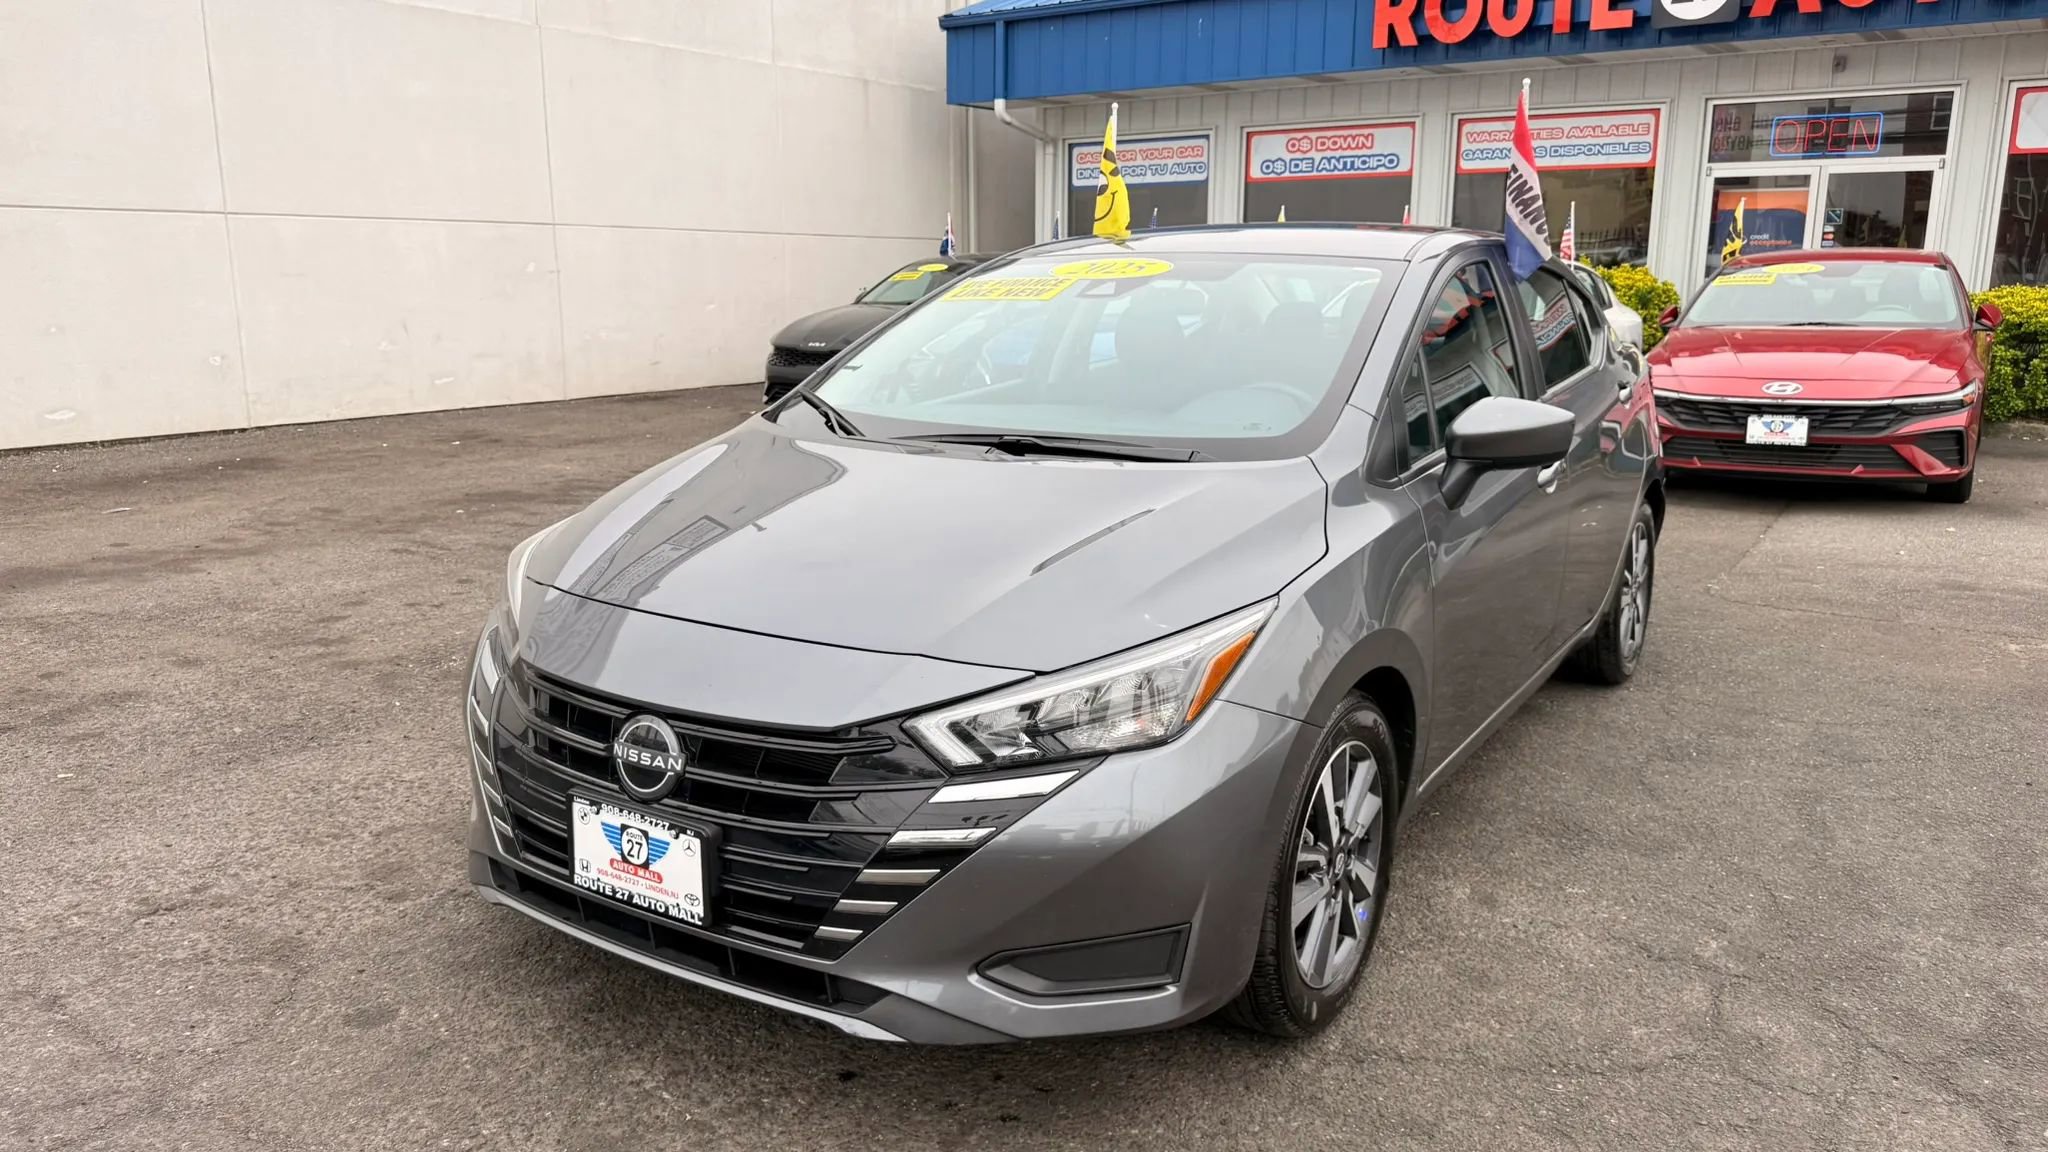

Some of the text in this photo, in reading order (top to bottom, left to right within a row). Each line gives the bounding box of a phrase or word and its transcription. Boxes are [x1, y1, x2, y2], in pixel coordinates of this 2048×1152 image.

[1315, 133, 1374, 152] DOWN
[1467, 123, 1651, 144] WARRATIES AVAILABLE
[1775, 118, 1880, 152] OPEN
[1077, 151, 1103, 165] CAS
[1140, 147, 1174, 161] YOUR
[1176, 146, 1203, 159] CAR
[1462, 141, 1652, 162] GARANS DISPONIBLES
[1077, 162, 1206, 180] DINE POR TU AUTO
[1289, 157, 1315, 174] DE
[1316, 153, 1400, 174] ANTICIPO
[998, 287, 1053, 297] NEW
[614, 744, 682, 771] NISSAN
[601, 803, 670, 831] 908-648-2727
[626, 831, 643, 840] ROUTE
[626, 839, 644, 860] 27
[596, 867, 640, 886] 908-648-2727
[612, 860, 661, 882] AUTO MALL
[573, 874, 703, 926] ROUTE 27 AUTO MALL
